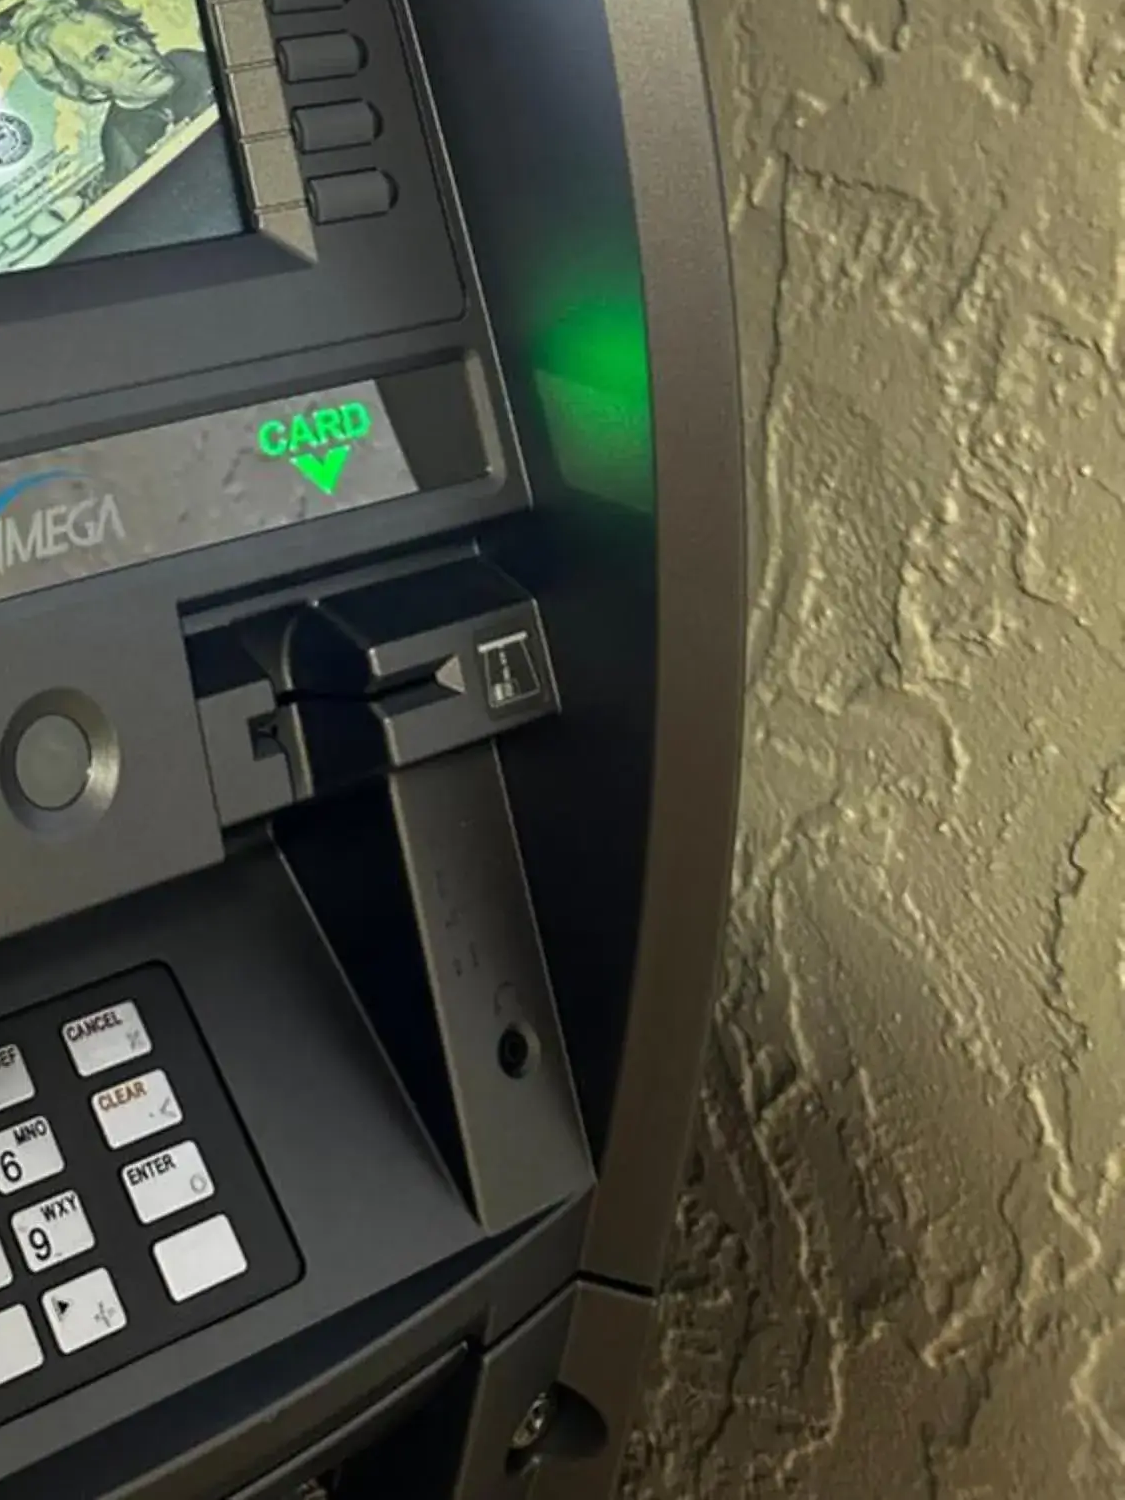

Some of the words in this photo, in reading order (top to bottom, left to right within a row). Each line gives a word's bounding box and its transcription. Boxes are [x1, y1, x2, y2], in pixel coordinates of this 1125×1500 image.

[257, 401, 372, 456] CARD
[66, 1011, 123, 1041] CANCEL
[98, 1081, 148, 1112] CLEAR
[13, 1119, 48, 1145] MNO
[0, 1150, 22, 1183] 6
[126, 1152, 177, 1187] ENTER
[40, 1195, 77, 1222] WXY
[28, 1227, 52, 1261] 9
